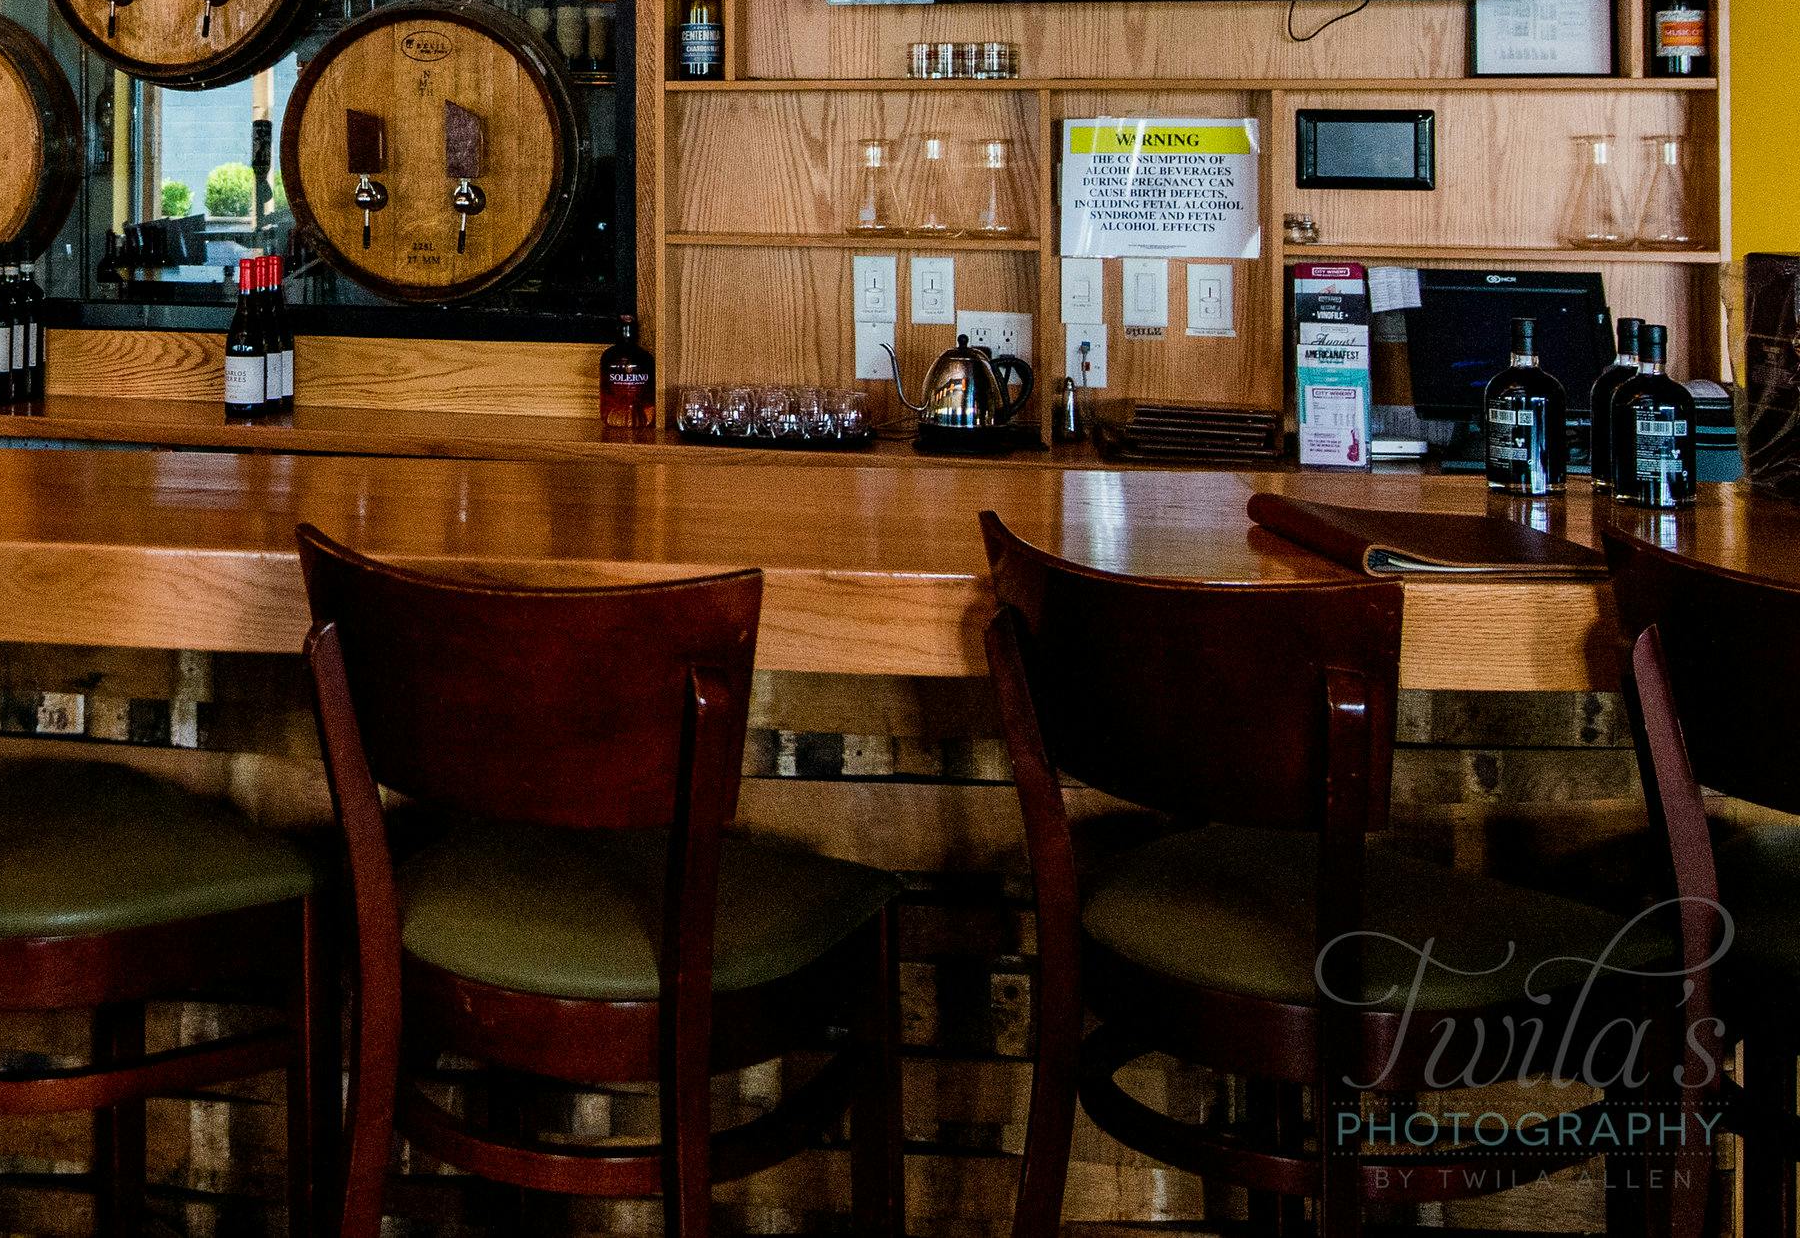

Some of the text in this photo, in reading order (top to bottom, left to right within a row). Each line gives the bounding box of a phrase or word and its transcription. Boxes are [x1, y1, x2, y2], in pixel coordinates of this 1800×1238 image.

[1116, 134, 1199, 147] WARNING
[1092, 155, 1225, 164] THE CONSUMPTION OF
[1160, 167, 1231, 175] BEVERAGES
[1083, 178, 1234, 187] DURING PREGNANCY CAN
[1090, 189, 1126, 197] CAUSE
[1170, 190, 1227, 198] DEFECTS,
[1075, 200, 1243, 210] INCLUDING FETAL ALCOHOL
[1090, 212, 1226, 221] SYNDROME AND FETAL
[1100, 223, 1215, 232] ALCOHOL EFFECTS
